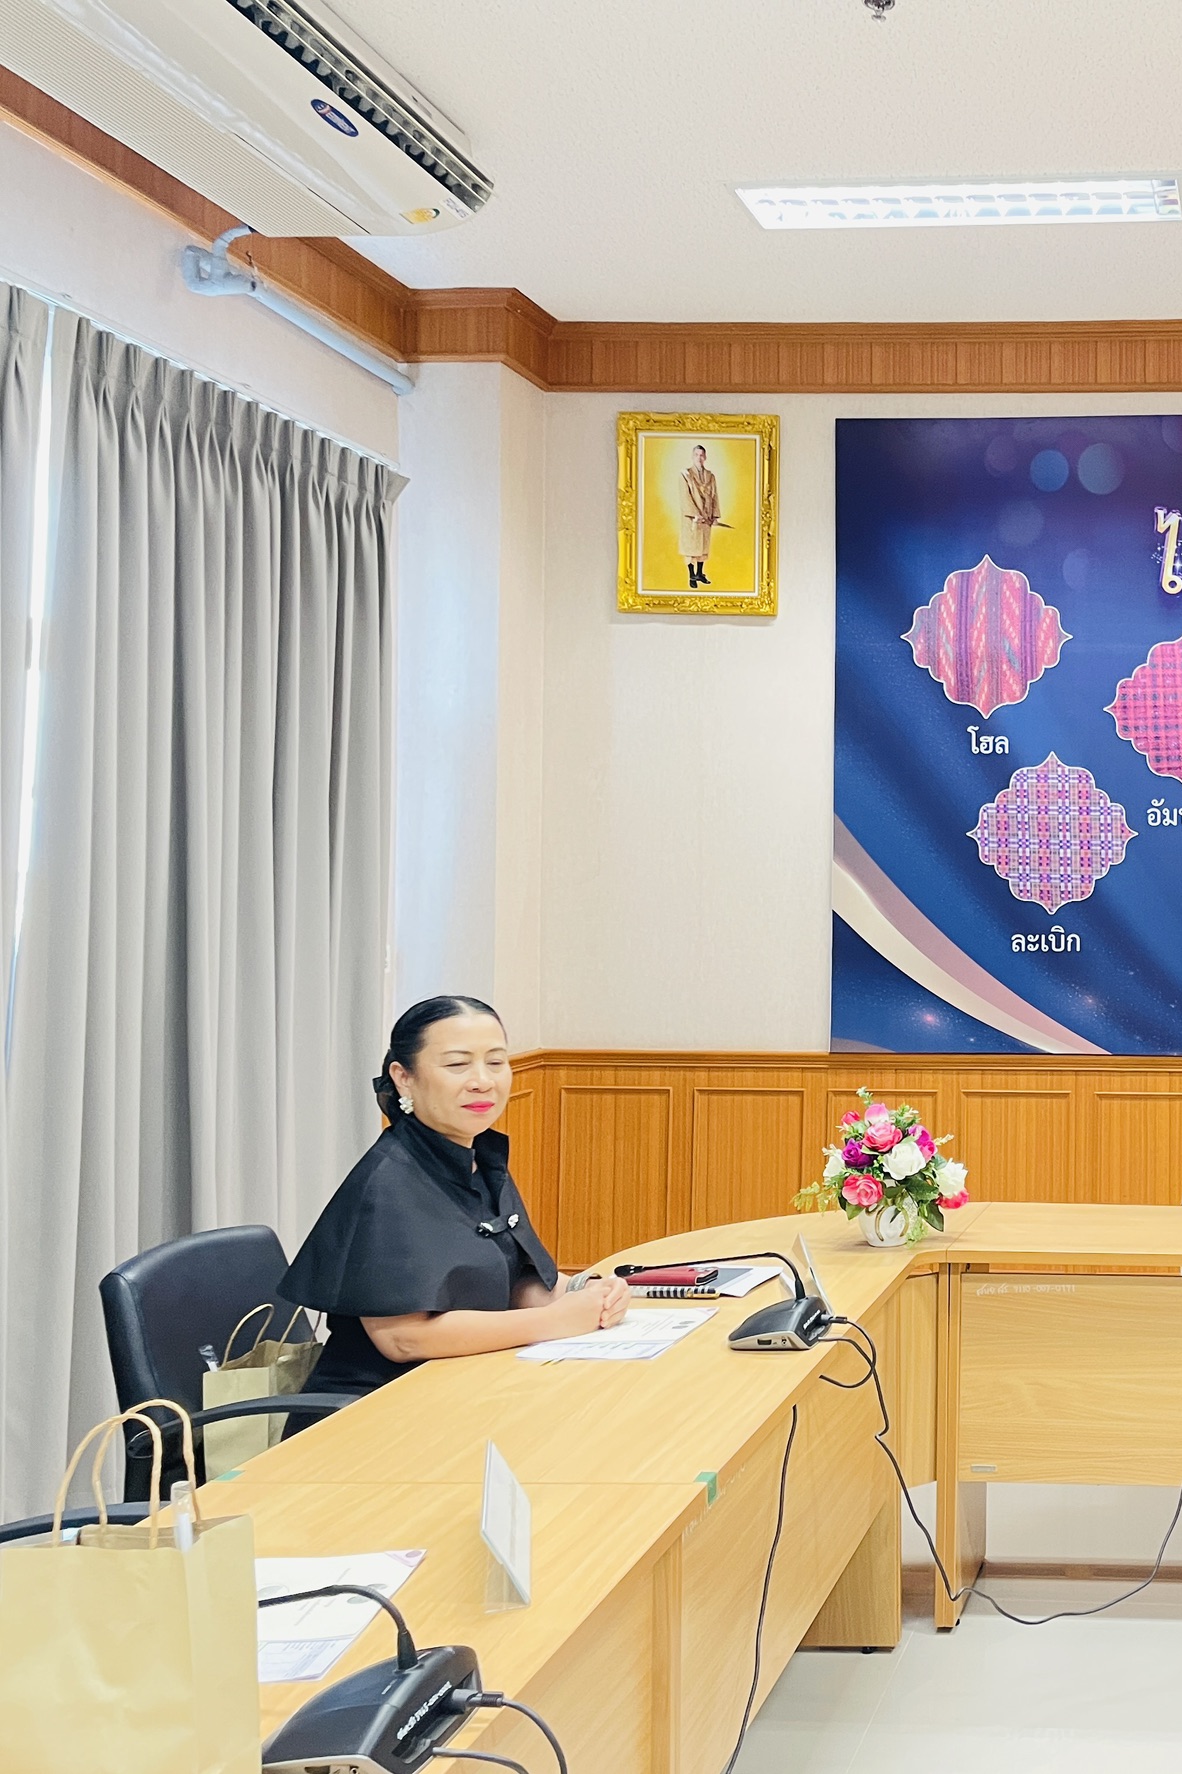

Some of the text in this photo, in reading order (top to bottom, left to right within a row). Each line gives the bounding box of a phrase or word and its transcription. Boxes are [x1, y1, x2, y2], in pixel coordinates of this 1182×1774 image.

[966, 725, 1010, 754] โฮล
[1010, 925, 1081, 952] ละเบิก
